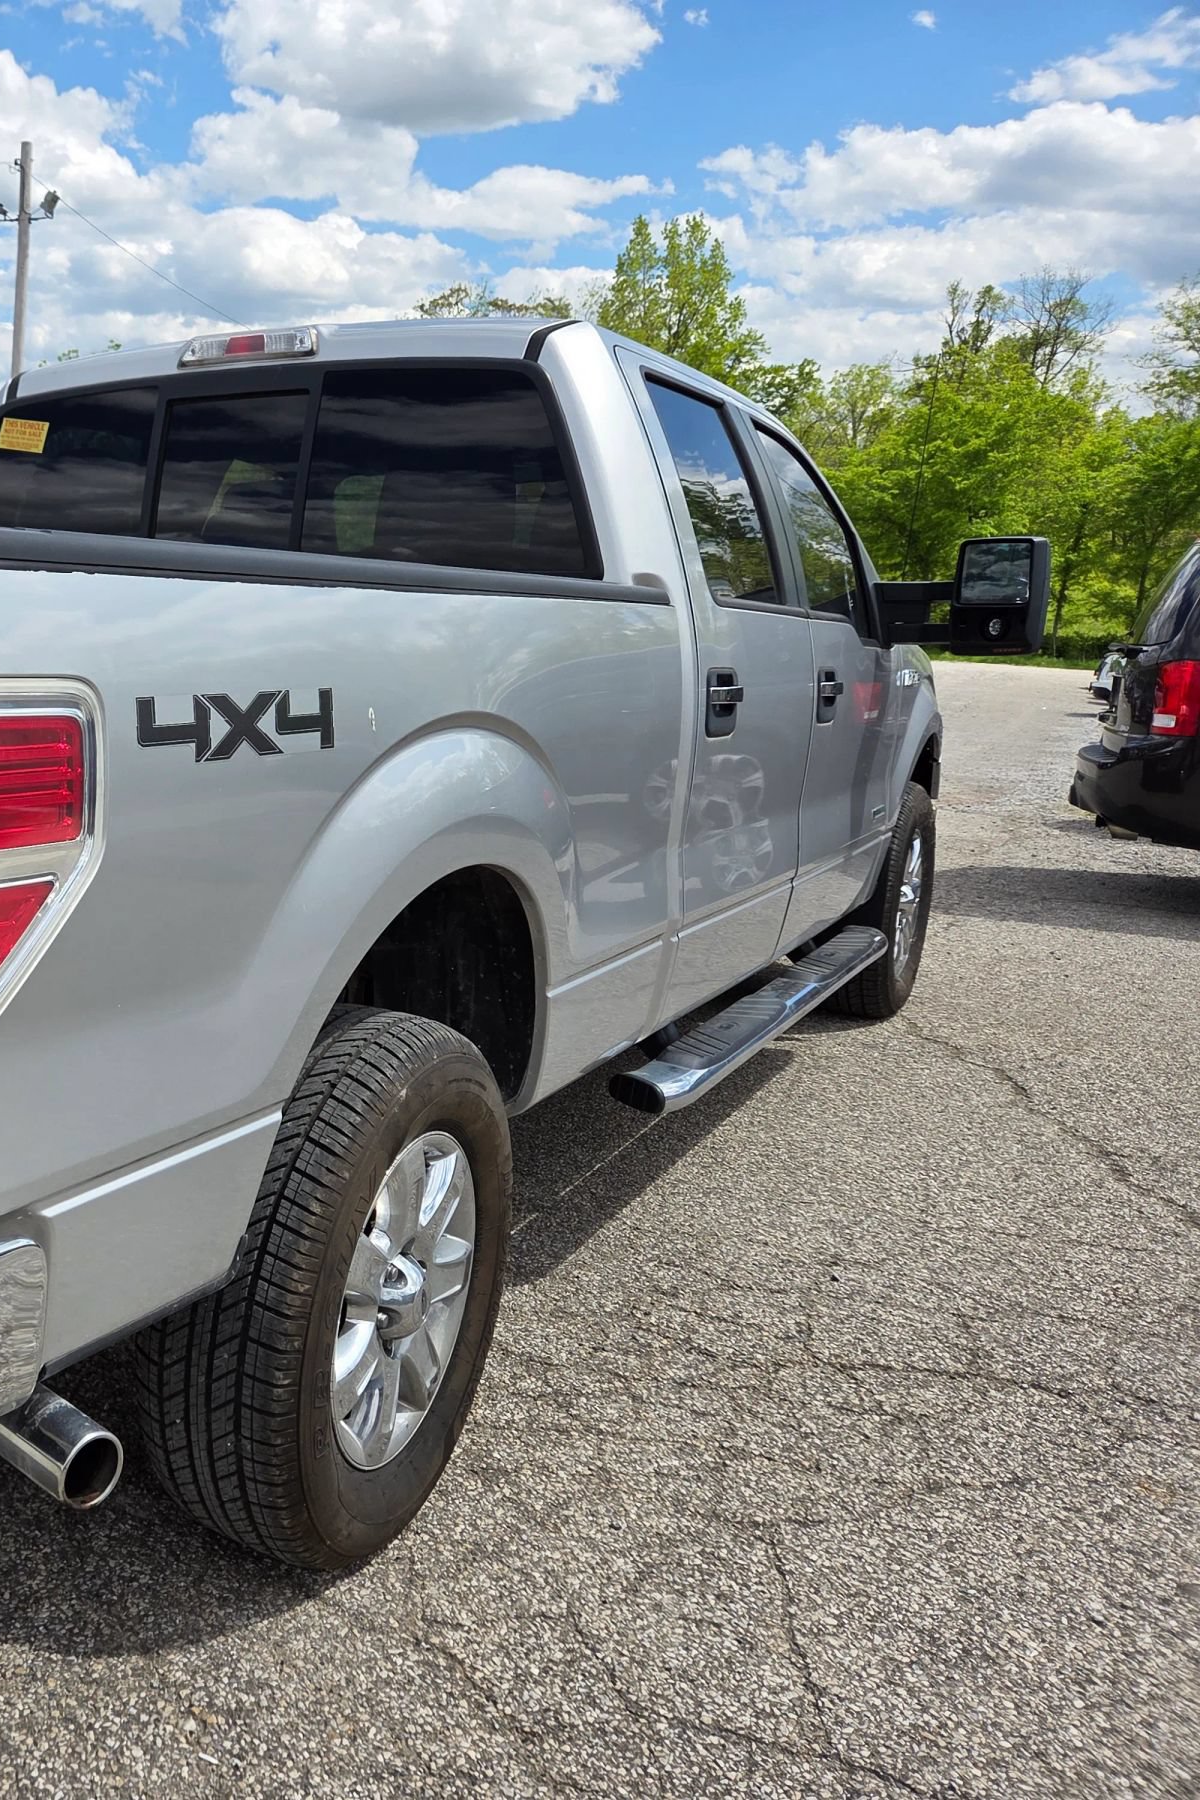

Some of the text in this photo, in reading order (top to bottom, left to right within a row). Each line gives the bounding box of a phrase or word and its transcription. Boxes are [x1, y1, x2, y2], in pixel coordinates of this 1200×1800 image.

[5, 419, 46, 431] THIS VEHICLE
[135, 687, 335, 763] 4X4
